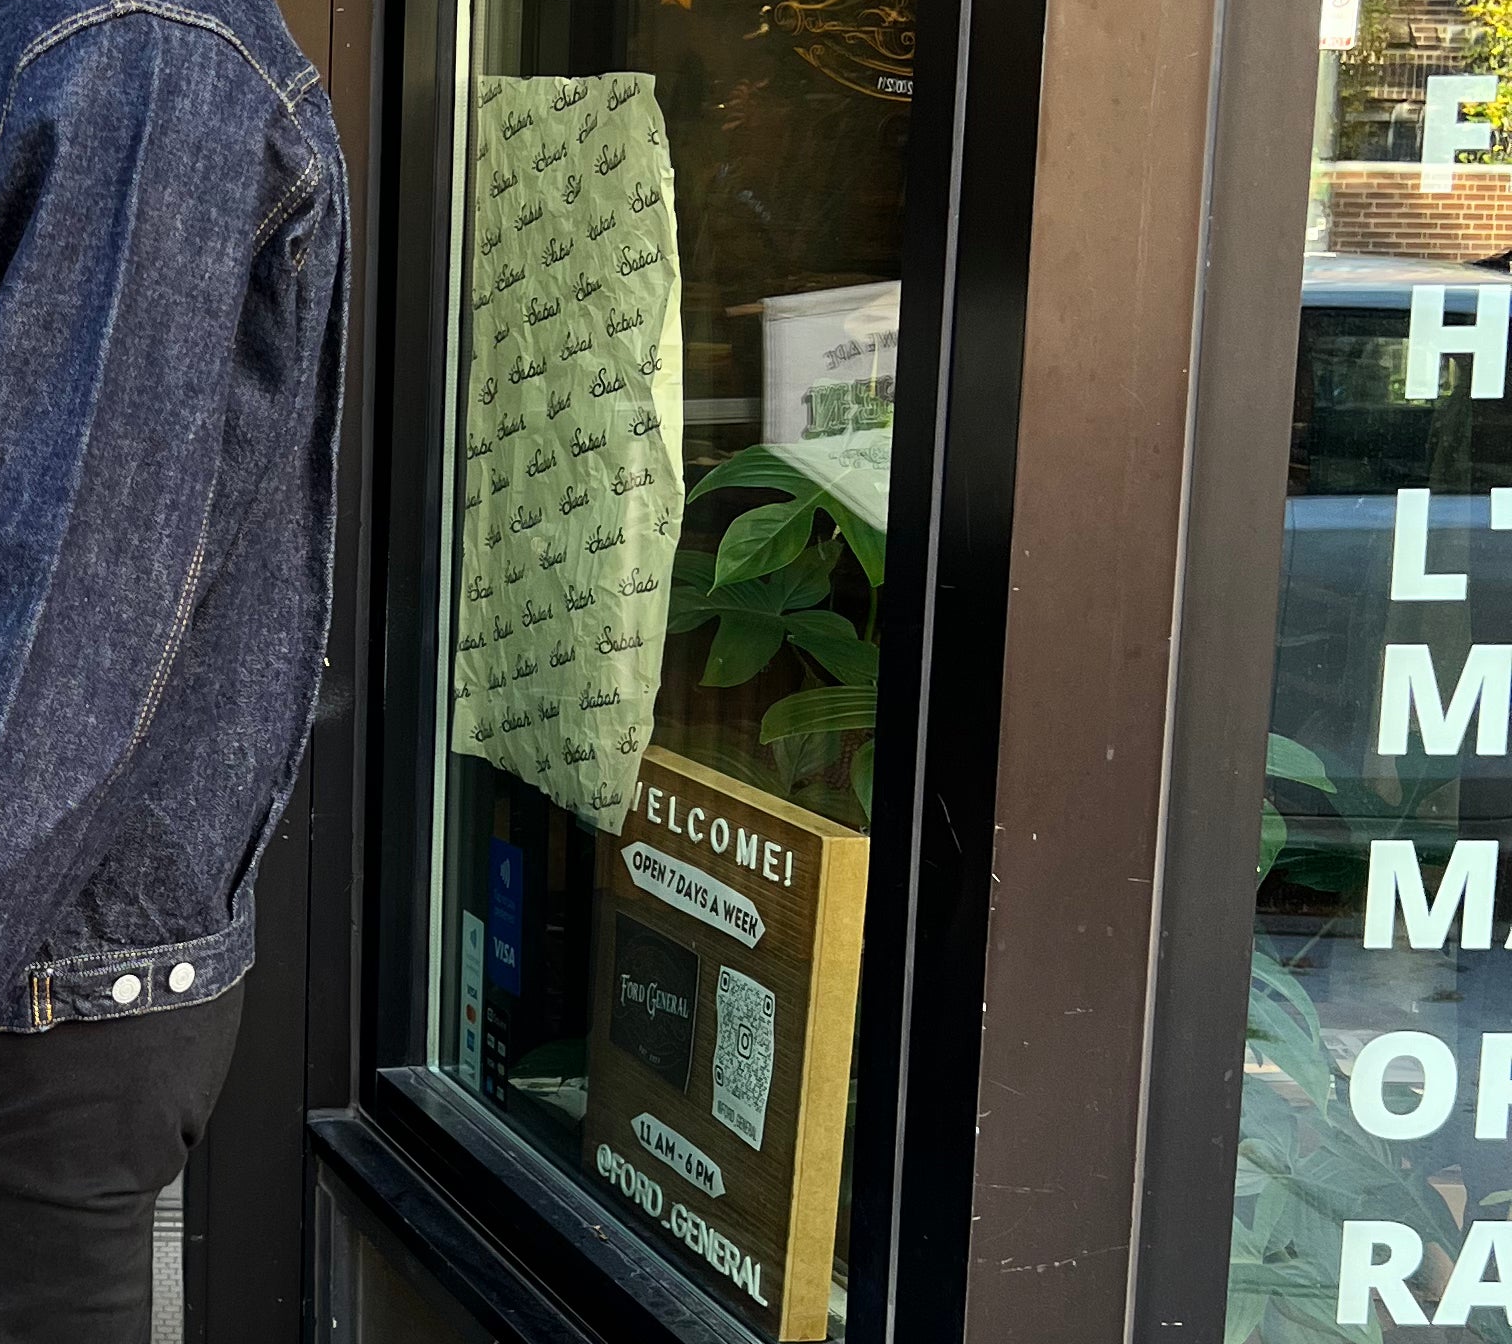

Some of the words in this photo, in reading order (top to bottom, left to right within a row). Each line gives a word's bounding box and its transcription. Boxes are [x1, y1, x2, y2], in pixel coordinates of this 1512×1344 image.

[631, 849, 667, 884] OPEN
[667, 869, 676, 888] 7
[676, 877, 709, 910] DAYS
[709, 895, 719, 917] A
[723, 900, 759, 939] WEEK
[492, 935, 516, 969] VISA
[619, 973, 645, 1007] FORD
[639, 1120, 653, 1146] 11
[654, 1134, 676, 1162] AM
[684, 1153, 693, 1175] 6
[695, 1160, 716, 1192] PM
